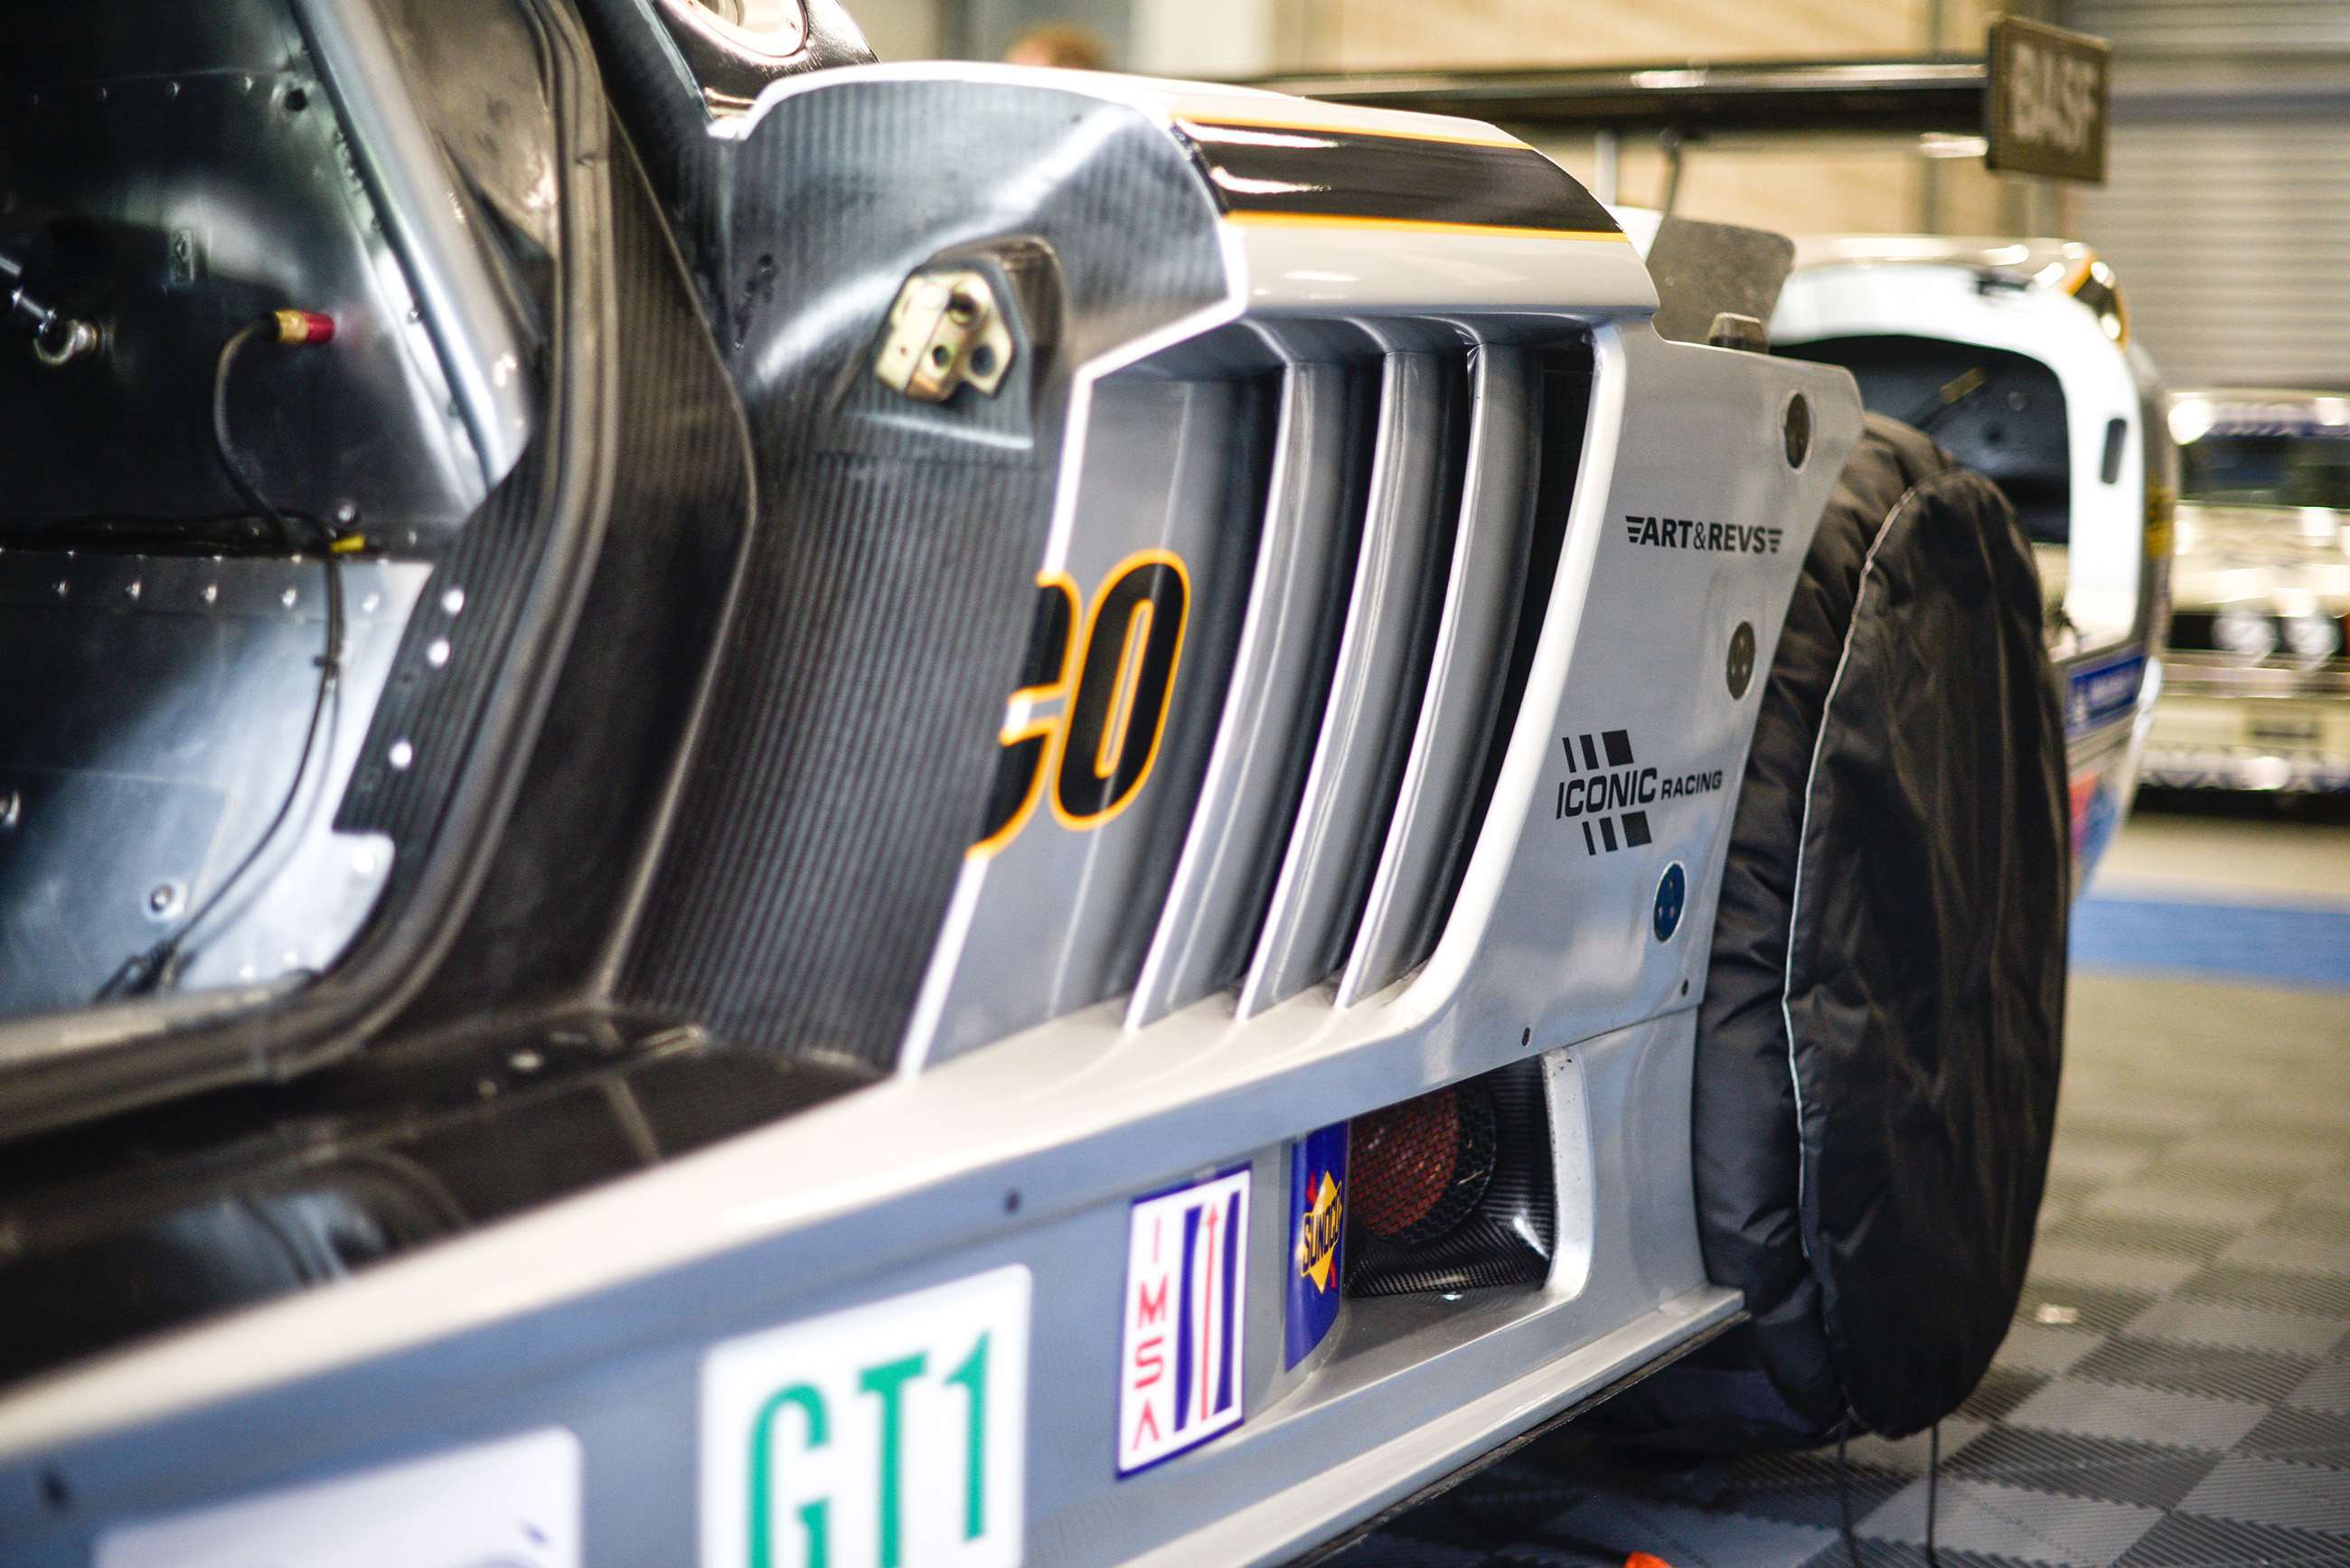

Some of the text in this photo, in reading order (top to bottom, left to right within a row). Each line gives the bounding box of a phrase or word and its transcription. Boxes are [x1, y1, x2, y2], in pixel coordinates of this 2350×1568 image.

[1640, 516, 1767, 555] ART&REVS
[1556, 767, 1723, 820] ICONIC RACING
[1302, 1189, 1342, 1275] SUNOCO
[1133, 1213, 1170, 1451] IMSA
[747, 1329, 991, 1568] GT1
